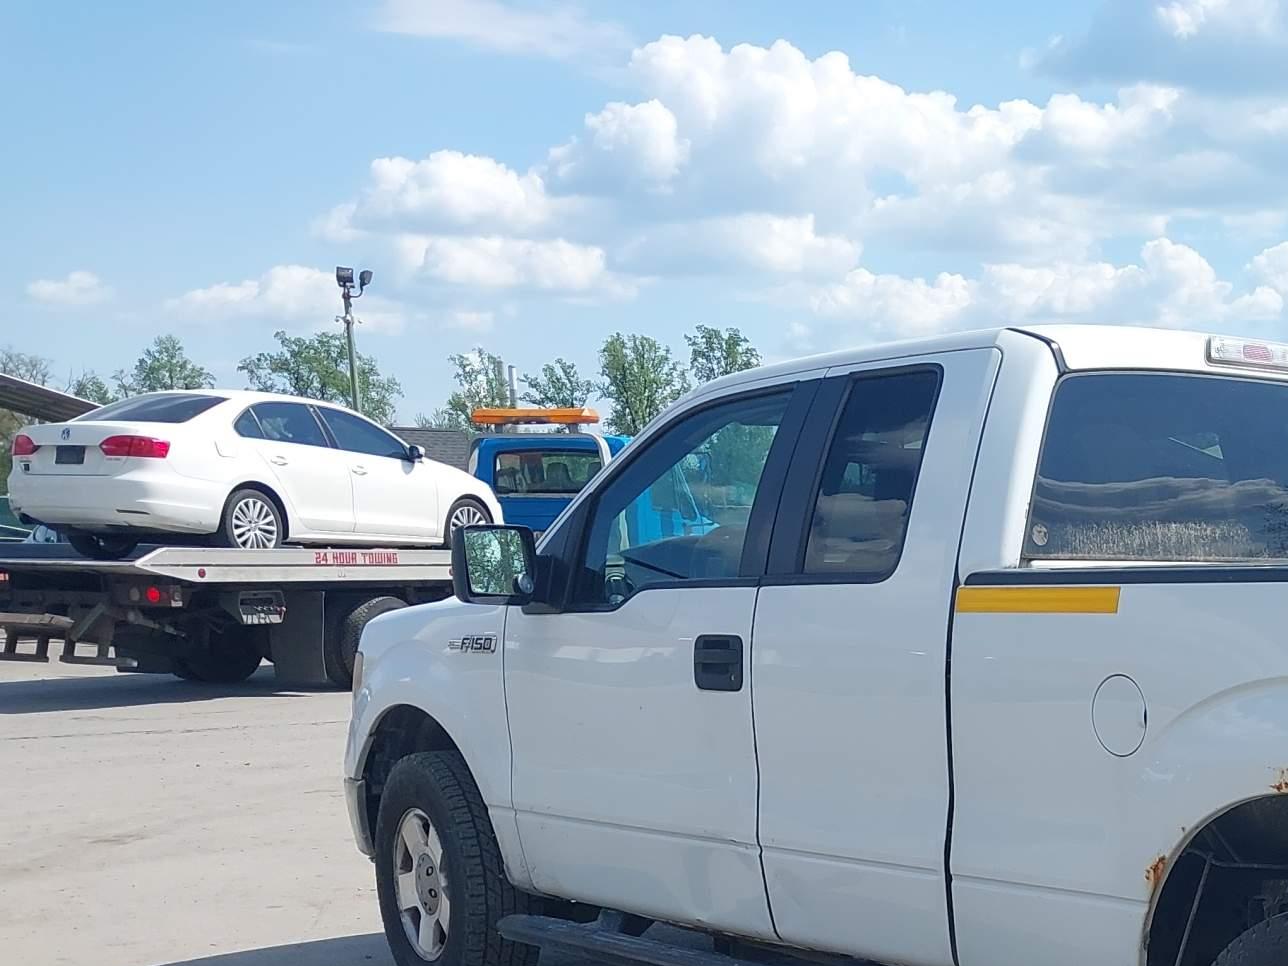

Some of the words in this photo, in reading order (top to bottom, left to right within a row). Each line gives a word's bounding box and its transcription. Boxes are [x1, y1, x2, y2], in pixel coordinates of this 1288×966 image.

[314, 551, 328, 564] 24
[332, 552, 357, 564] HOUR
[360, 552, 398, 564] TOWING
